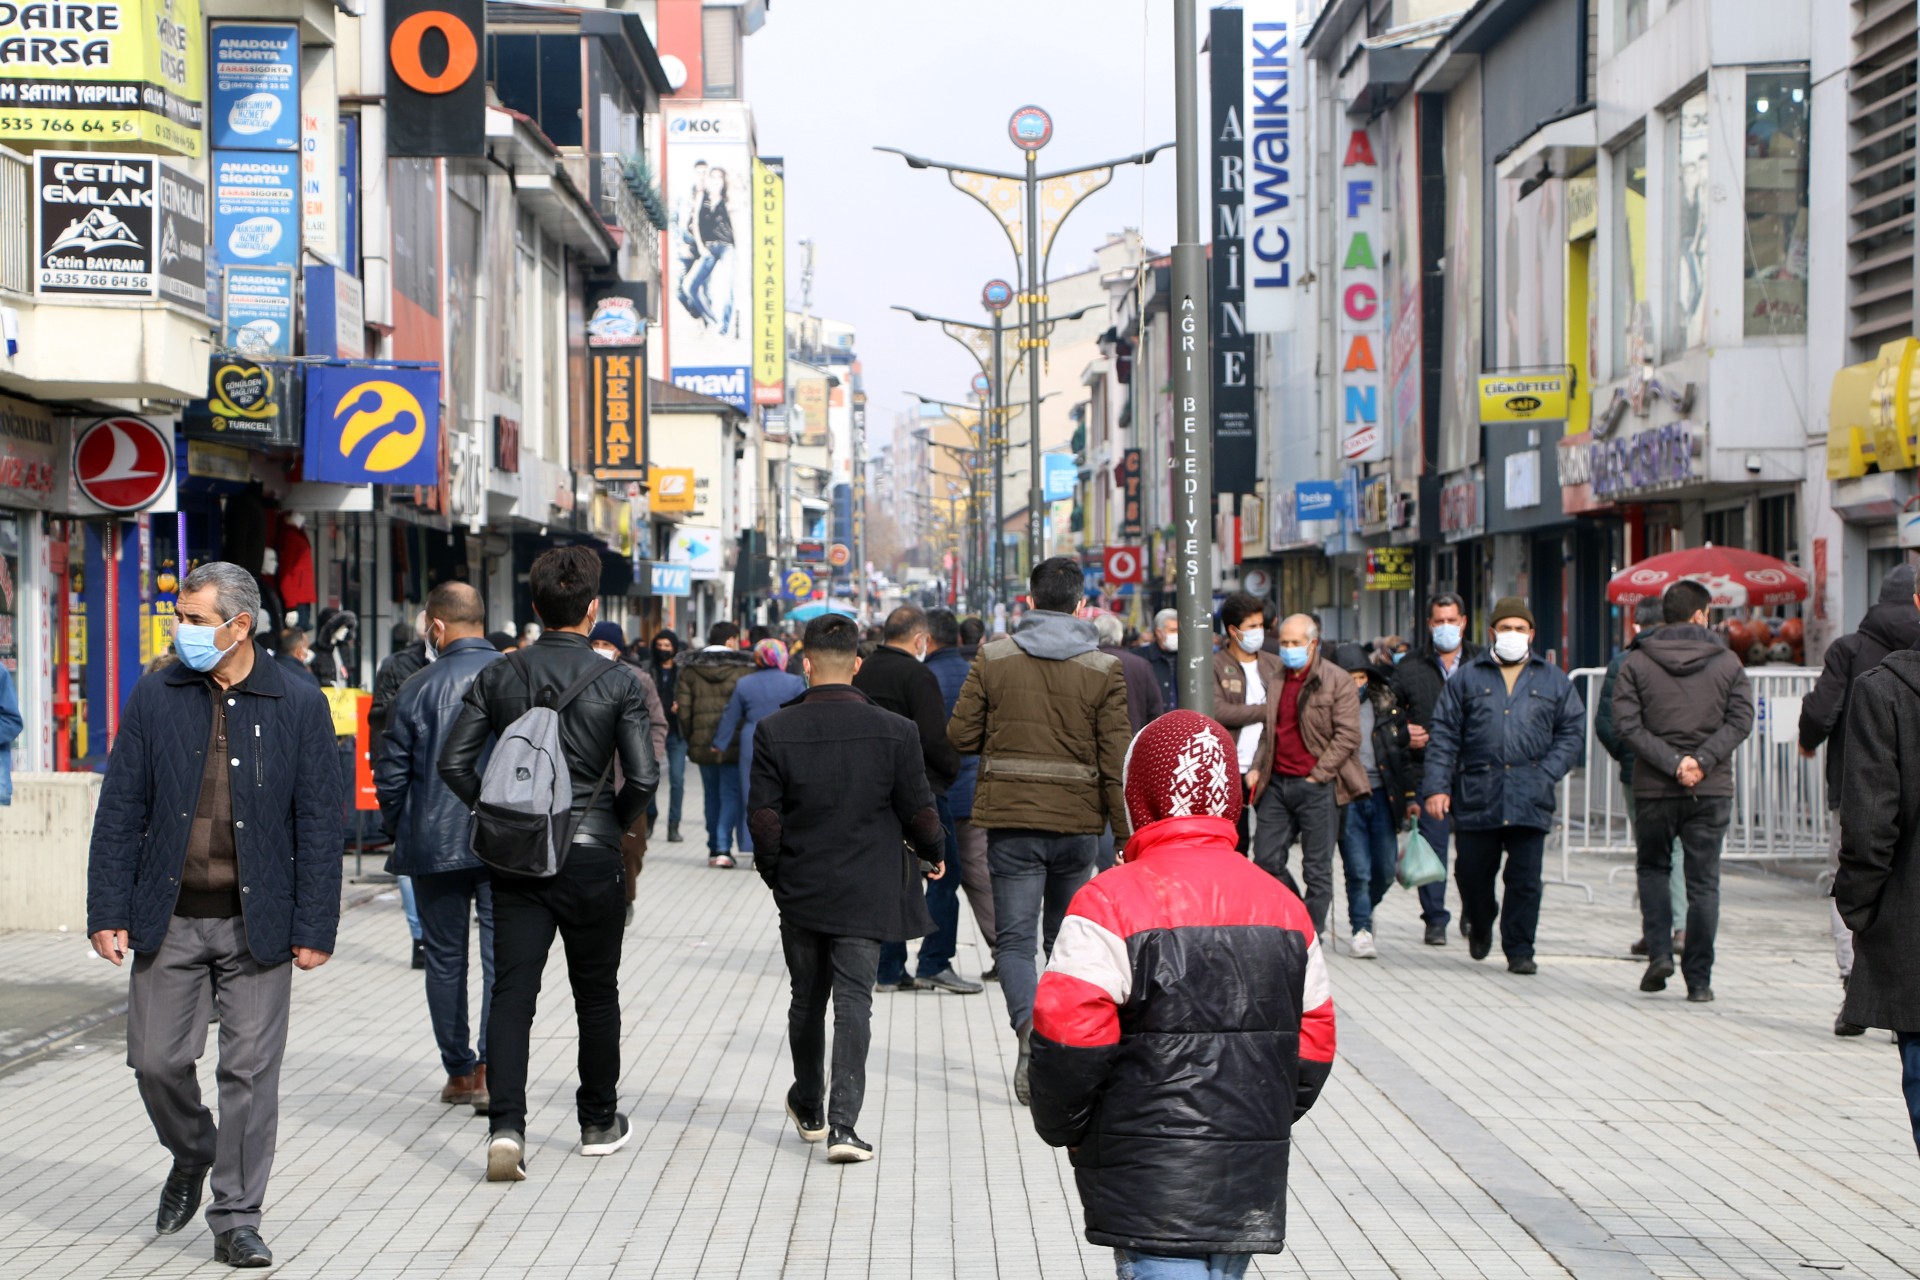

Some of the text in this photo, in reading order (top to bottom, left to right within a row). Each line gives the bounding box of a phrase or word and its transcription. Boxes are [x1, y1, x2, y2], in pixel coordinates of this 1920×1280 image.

[0, 38, 109, 66] ARSA
[219, 39, 287, 50] ANADOLU
[219, 48, 280, 60] SİGORTA
[20, 84, 71, 103] SATIM
[75, 86, 138, 104] YAPILIR
[1, 117, 133, 132] 535 766 64 56
[689, 120, 720, 133] KOÇ
[53, 160, 145, 184] ÇETİN
[220, 163, 289, 175] ANADOLU
[220, 172, 281, 185] SİGORTA
[42, 184, 152, 207] EMLAK
[764, 174, 775, 224] OKUL
[1218, 104, 1246, 388] ARMİNE
[47, 256, 145, 272] Çetin BAYRAM
[1253, 225, 1290, 288] LC
[42, 273, 149, 288] 0.535 766 64 56
[230, 275, 287, 286] ANADOLU
[1343, 129, 1377, 423] AFACAN
[675, 368, 745, 394] mavi
[606, 356, 631, 465] KEBAP
[228, 420, 272, 432] TURKCELL
[1183, 397, 1199, 595] BELEDİYESİ
[1299, 491, 1332, 503] beko
[652, 568, 687, 588] KVK
